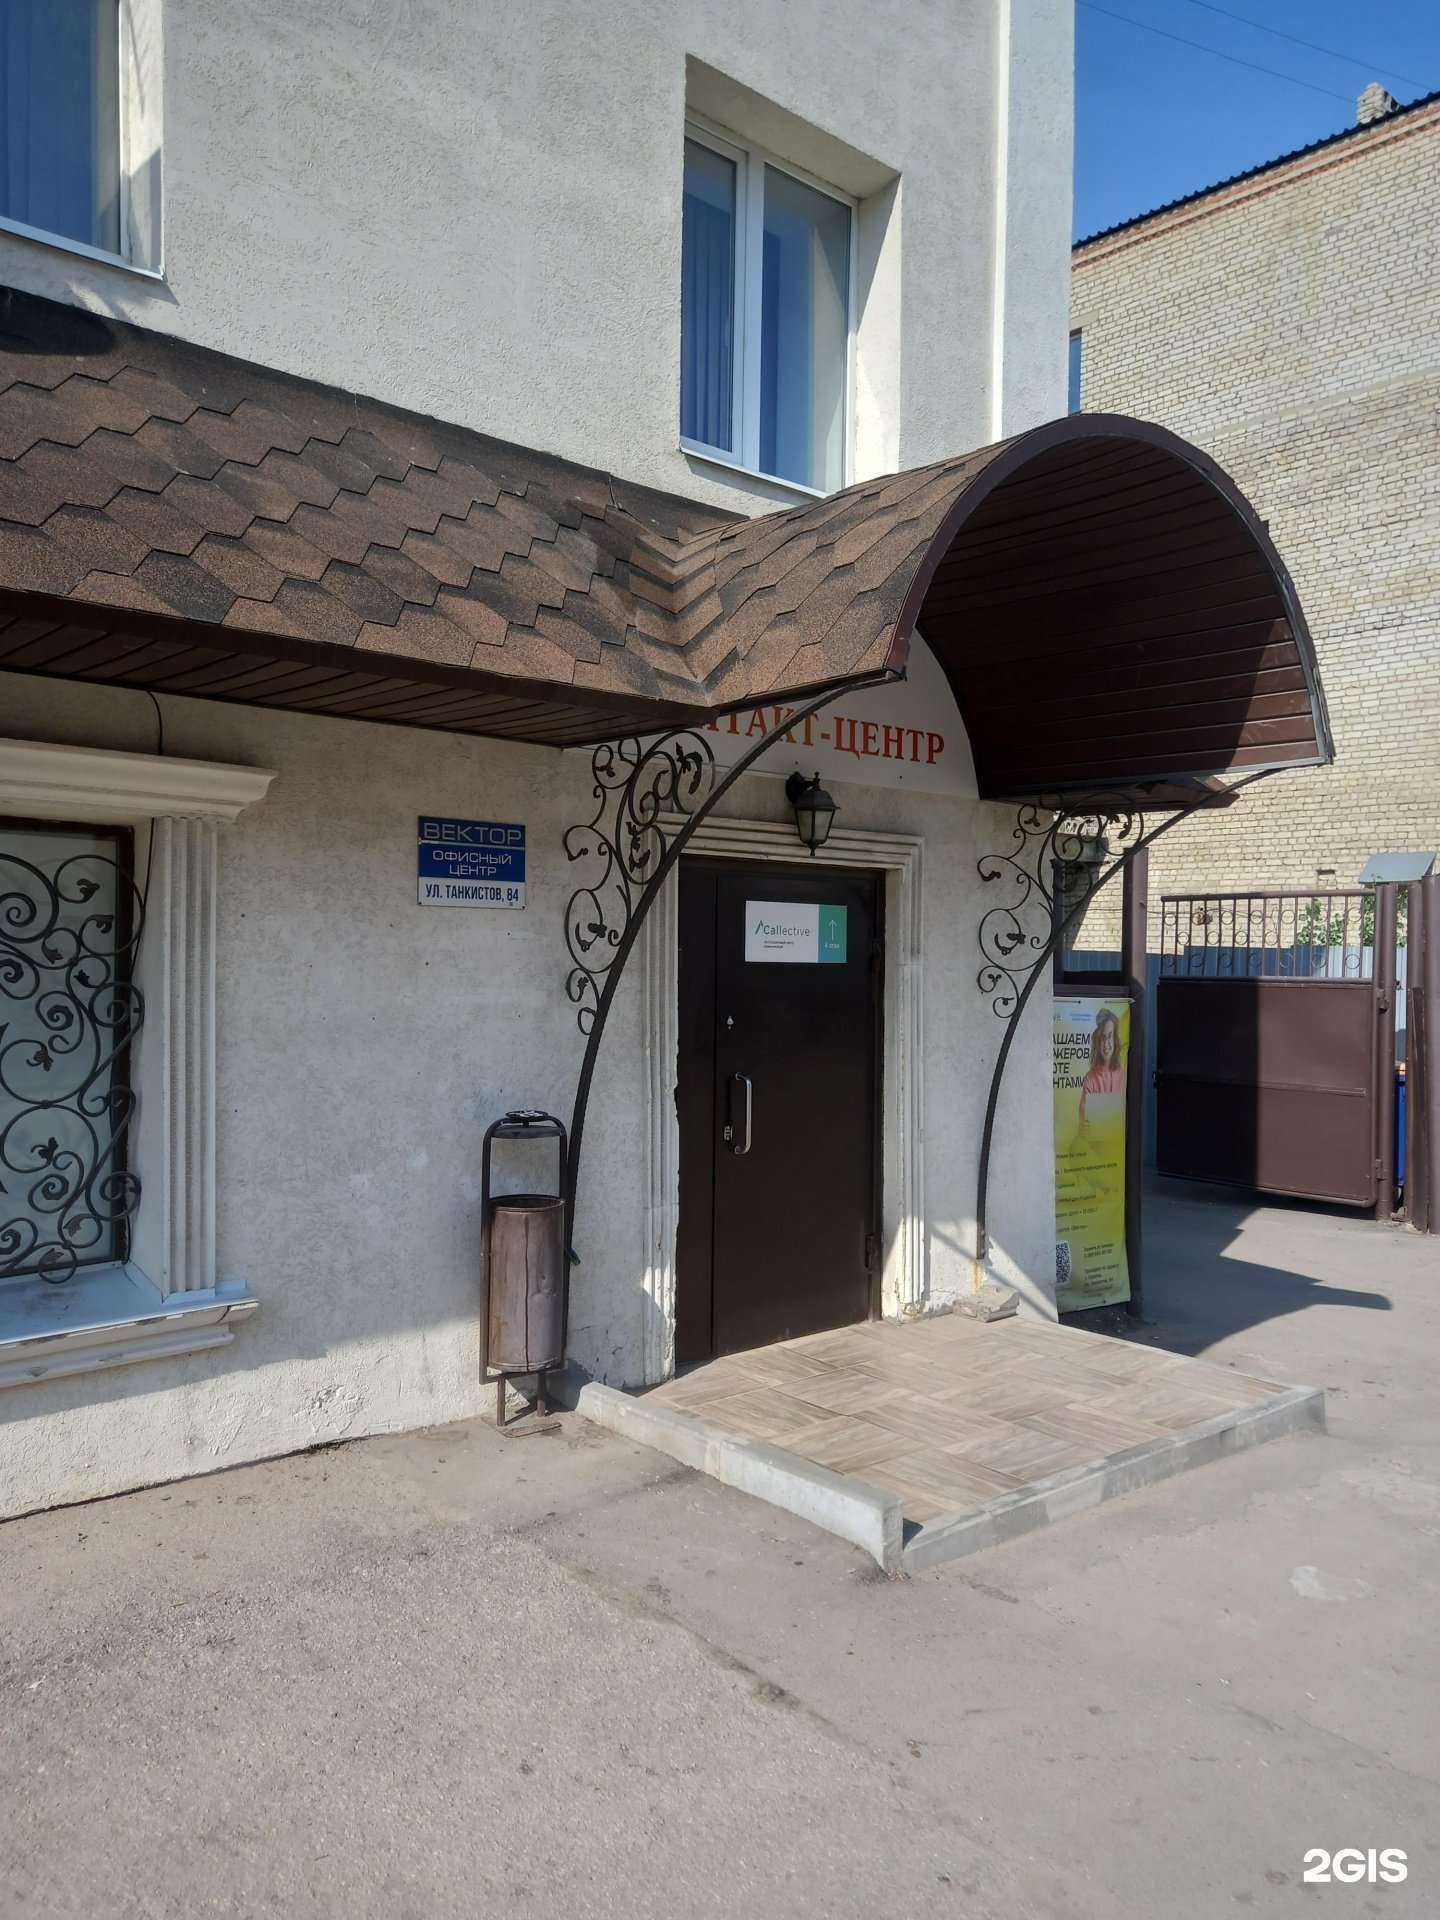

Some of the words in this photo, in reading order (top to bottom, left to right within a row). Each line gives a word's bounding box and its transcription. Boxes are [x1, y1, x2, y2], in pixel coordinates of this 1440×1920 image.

[698, 704, 945, 765] ТАКТ-ЦЕНТР
[423, 822, 522, 845] ВЕКТОР
[432, 850, 512, 865] ОФИСНЫЙ
[449, 864, 497, 876] ЦЕНТР
[425, 883, 443, 898] УЛ.
[445, 885, 505, 902] ТАНКИСТОВ,
[507, 888, 519, 901] 84
[763, 924, 811, 937] Callective
